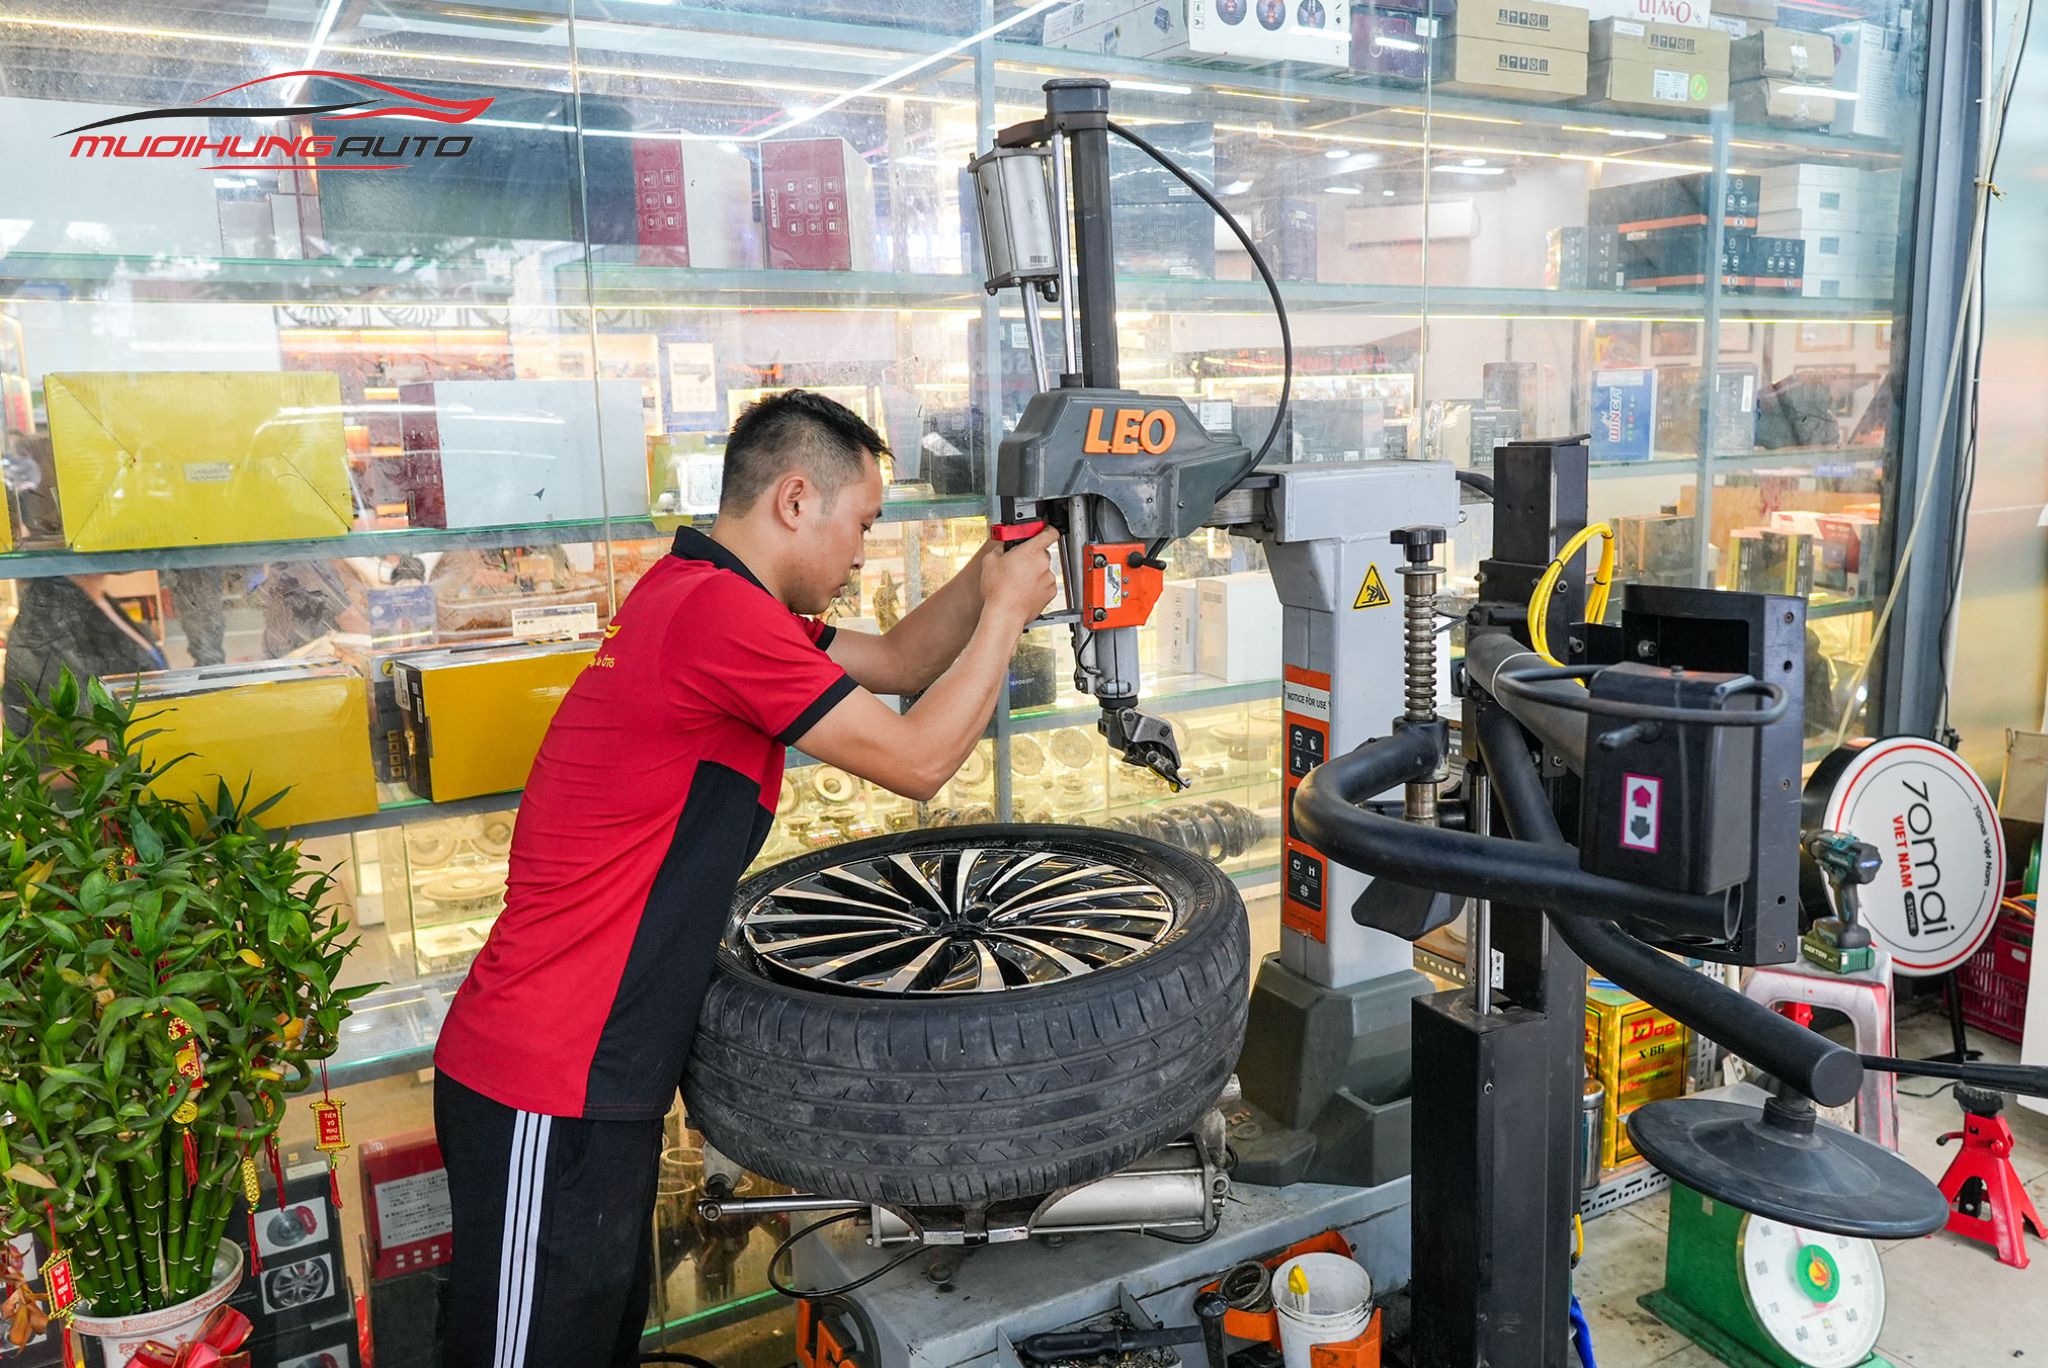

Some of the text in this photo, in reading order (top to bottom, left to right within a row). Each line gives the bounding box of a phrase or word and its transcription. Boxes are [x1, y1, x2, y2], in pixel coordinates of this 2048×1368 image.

[1083, 407, 1176, 455] LEO
[1287, 692, 1327, 710] NOTICE FOR USE
[1892, 815, 1913, 888] VIET NAM
[1983, 859, 1992, 887] Nam
[1906, 898, 1917, 931] STORE
[1755, 1260, 1768, 1275] 80
[1846, 1308, 1858, 1322] 40
[1795, 1325, 1809, 1342] 60
[1826, 1333, 1837, 1346] 50
